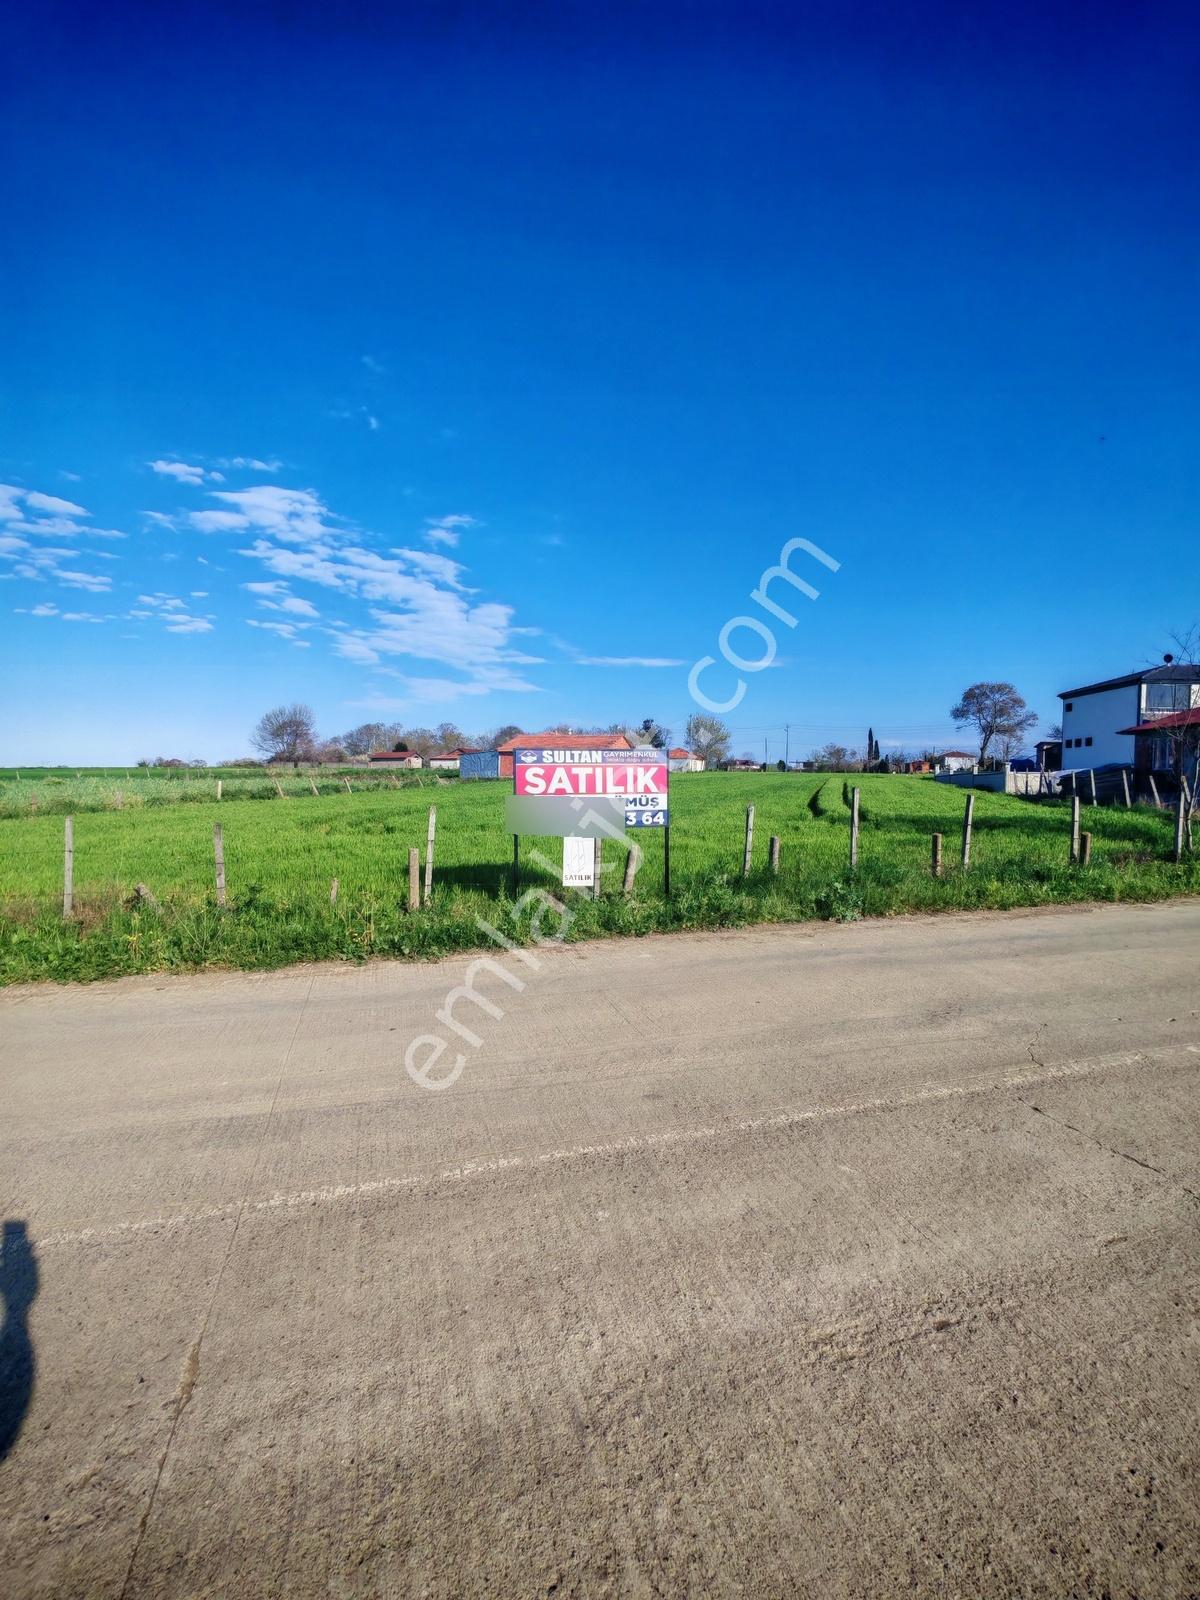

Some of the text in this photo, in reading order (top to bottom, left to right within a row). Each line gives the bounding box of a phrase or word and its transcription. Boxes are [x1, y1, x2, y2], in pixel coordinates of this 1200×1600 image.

[543, 750, 602, 763] SULTAN
[524, 767, 659, 794] SATILIK
[615, 795, 659, 808] MÜŞ
[642, 812, 664, 825] 64
